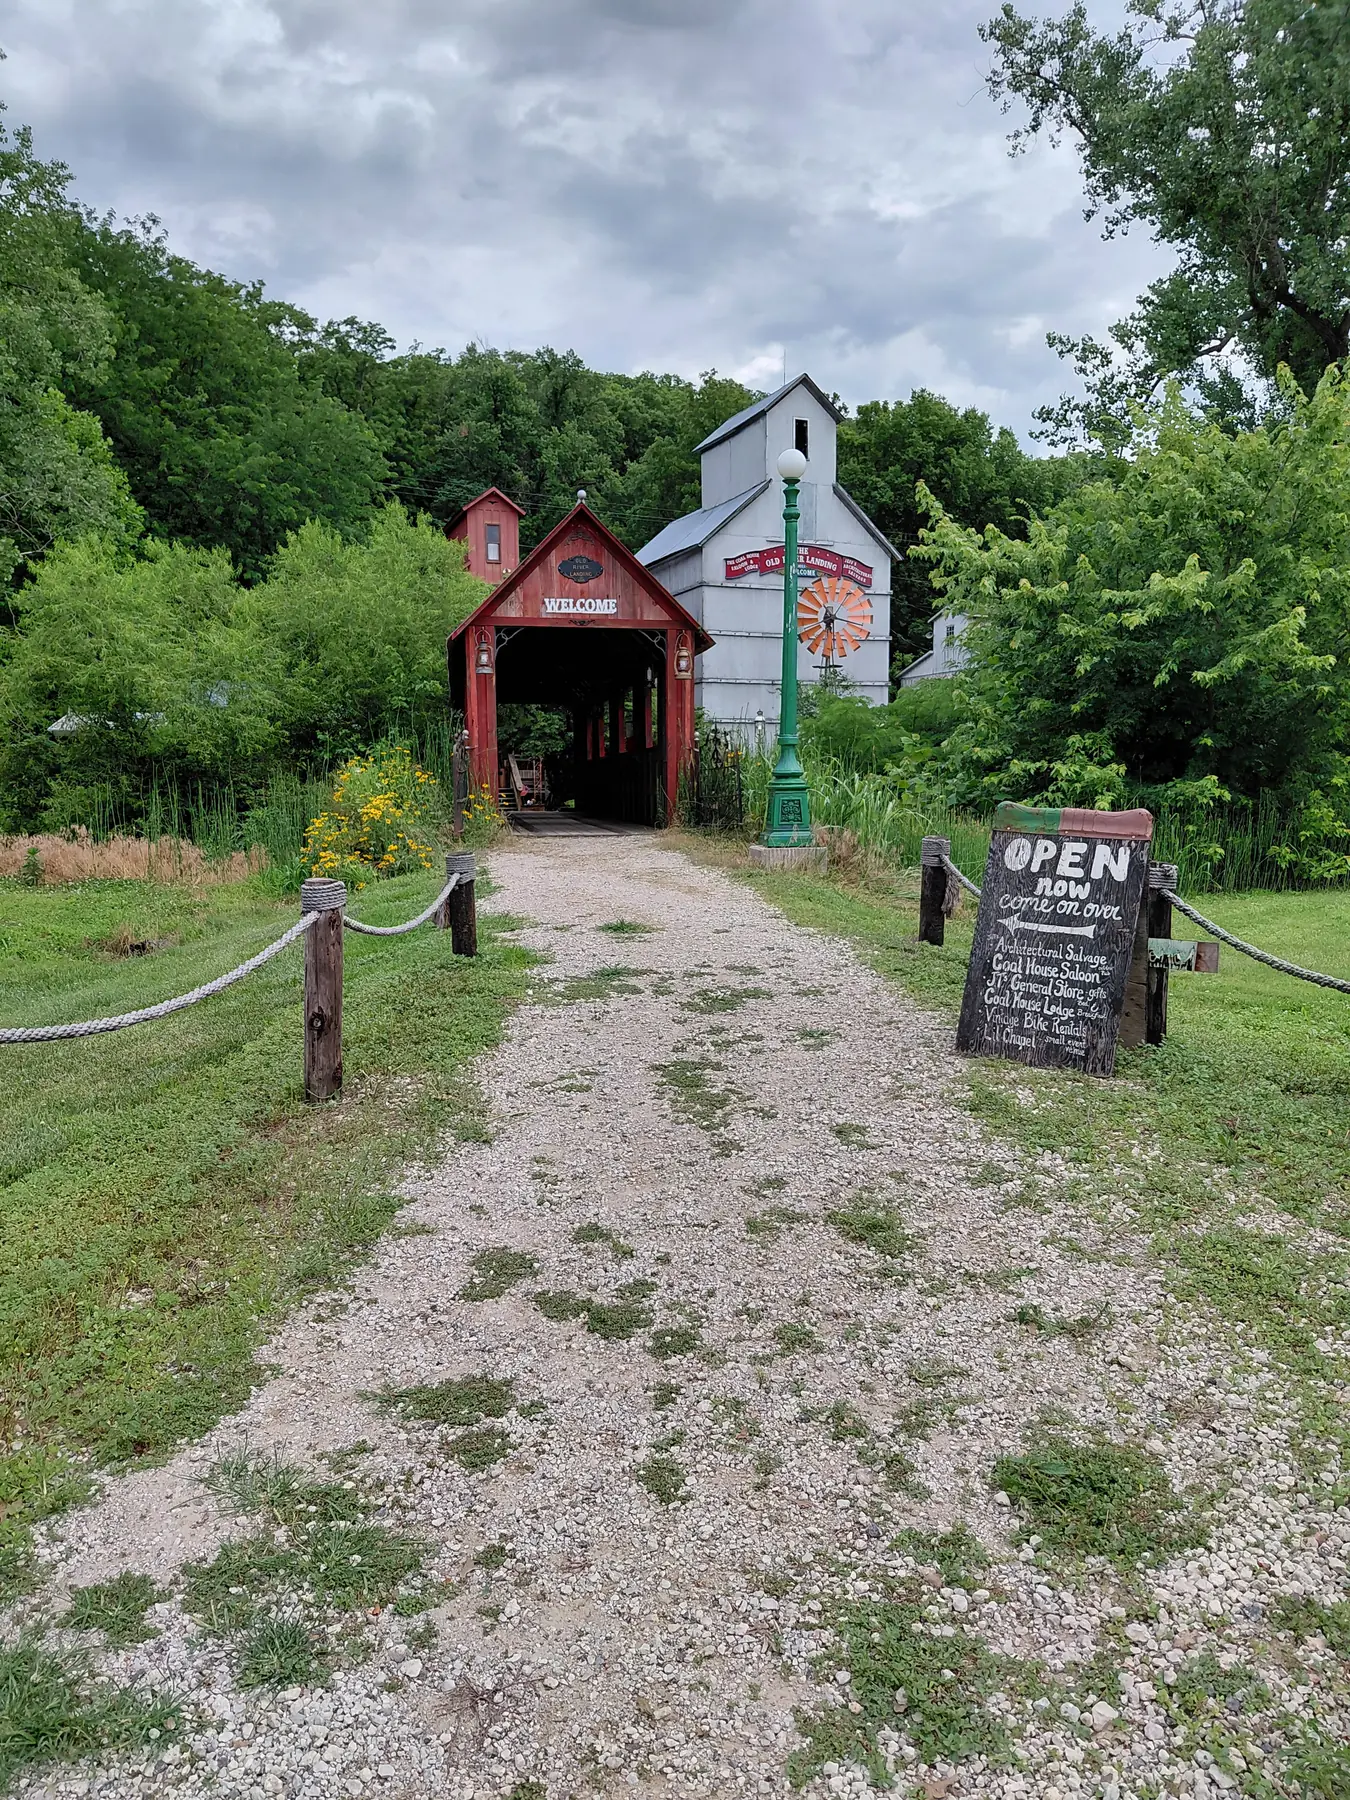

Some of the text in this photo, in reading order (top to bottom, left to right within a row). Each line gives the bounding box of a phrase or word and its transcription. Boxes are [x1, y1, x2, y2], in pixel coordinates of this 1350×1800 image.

[765, 557, 780, 567] OLD
[806, 556, 837, 571] LANDING
[544, 598, 617, 613] WELCOME
[1004, 838, 1131, 881] OPEN
[1034, 877, 1090, 900] now
[999, 894, 1122, 920] come on over
[995, 936, 1107, 968] Architectural Salvage
[992, 953, 1101, 984] Coal House Saloon
[1010, 974, 1053, 996] General
[1054, 979, 1084, 1000] Store
[984, 987, 1076, 1020] Coal House Lodge
[1023, 1012, 1049, 1031] Bike
[1051, 1017, 1088, 1037] Rentals
[1003, 1028, 1036, 1049] Chapel
[1044, 1035, 1066, 1045] small
[1067, 1039, 1087, 1049] event
